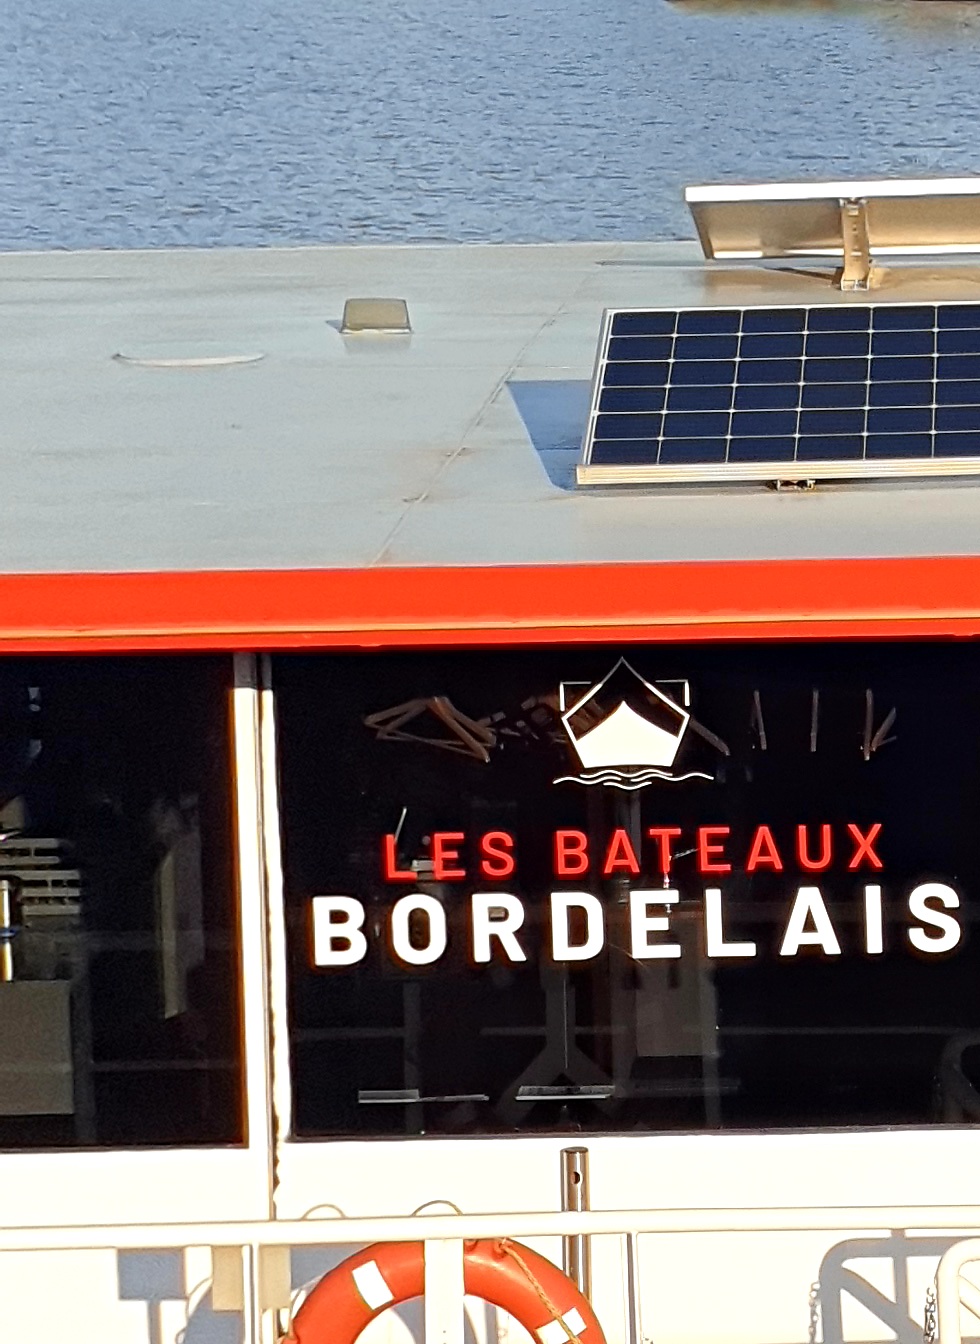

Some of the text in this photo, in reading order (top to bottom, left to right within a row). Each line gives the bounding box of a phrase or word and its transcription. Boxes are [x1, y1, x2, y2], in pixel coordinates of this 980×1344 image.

[384, 823, 883, 881] LES BATEAUX
[312, 882, 961, 966] BORDELAIS
